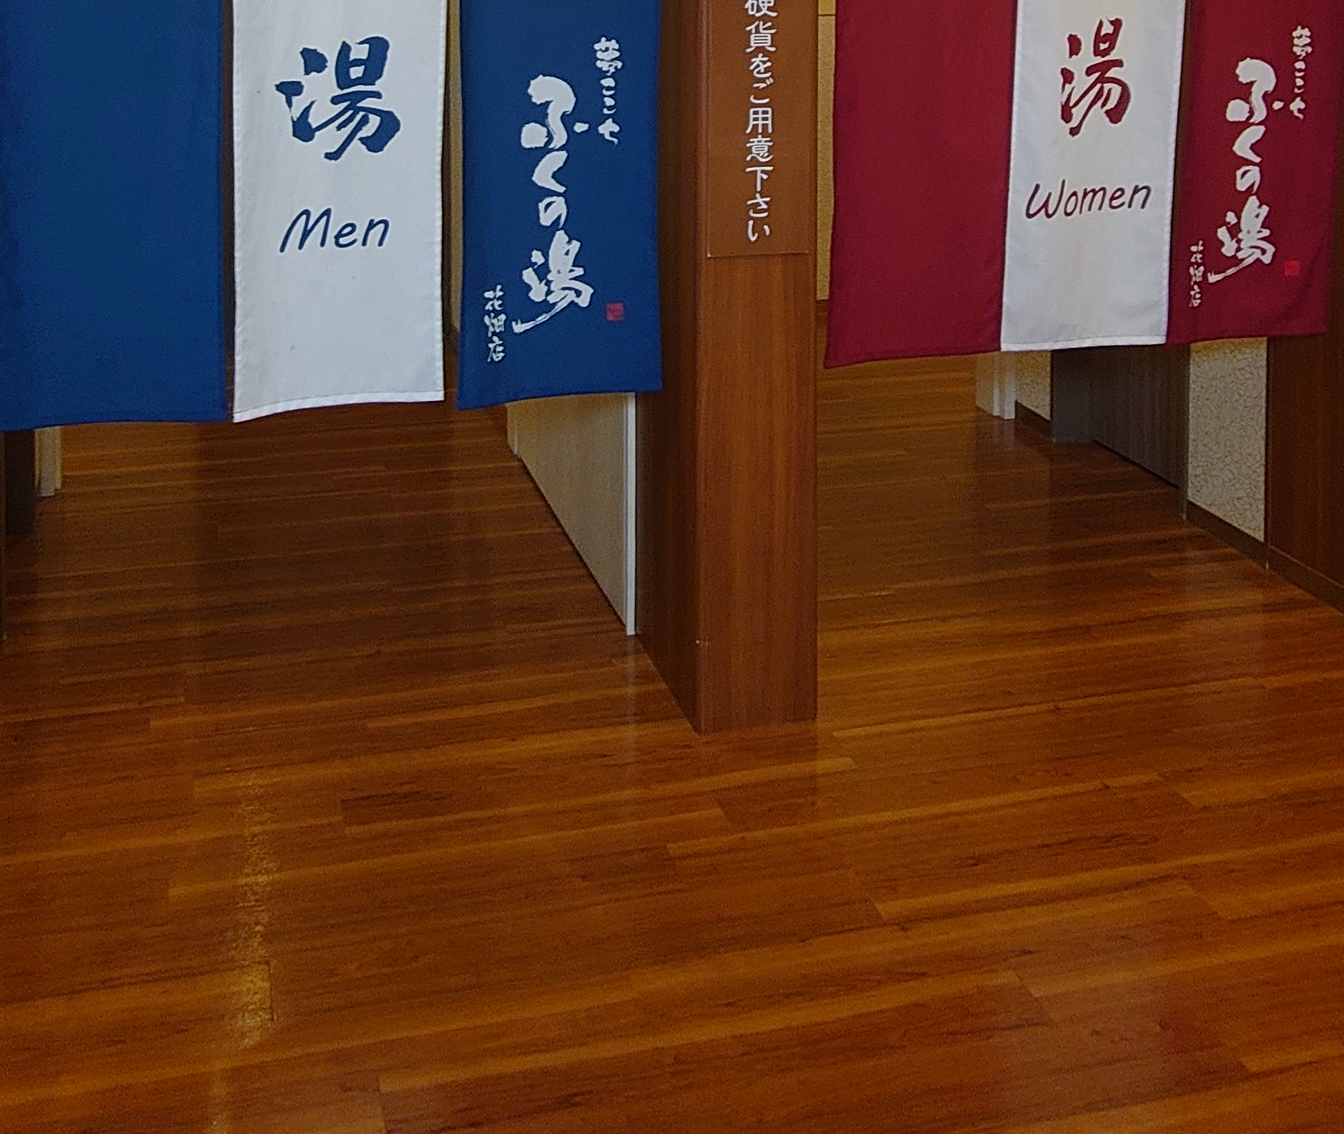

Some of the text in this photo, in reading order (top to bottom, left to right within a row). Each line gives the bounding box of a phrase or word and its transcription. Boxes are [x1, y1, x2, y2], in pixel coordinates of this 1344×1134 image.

[511, 74, 594, 334] ふくの湯
[1024, 178, 1153, 219] Women
[1206, 57, 1284, 284] ふくの湯
[278, 207, 391, 254] Men
[483, 284, 507, 363] 花畑店
